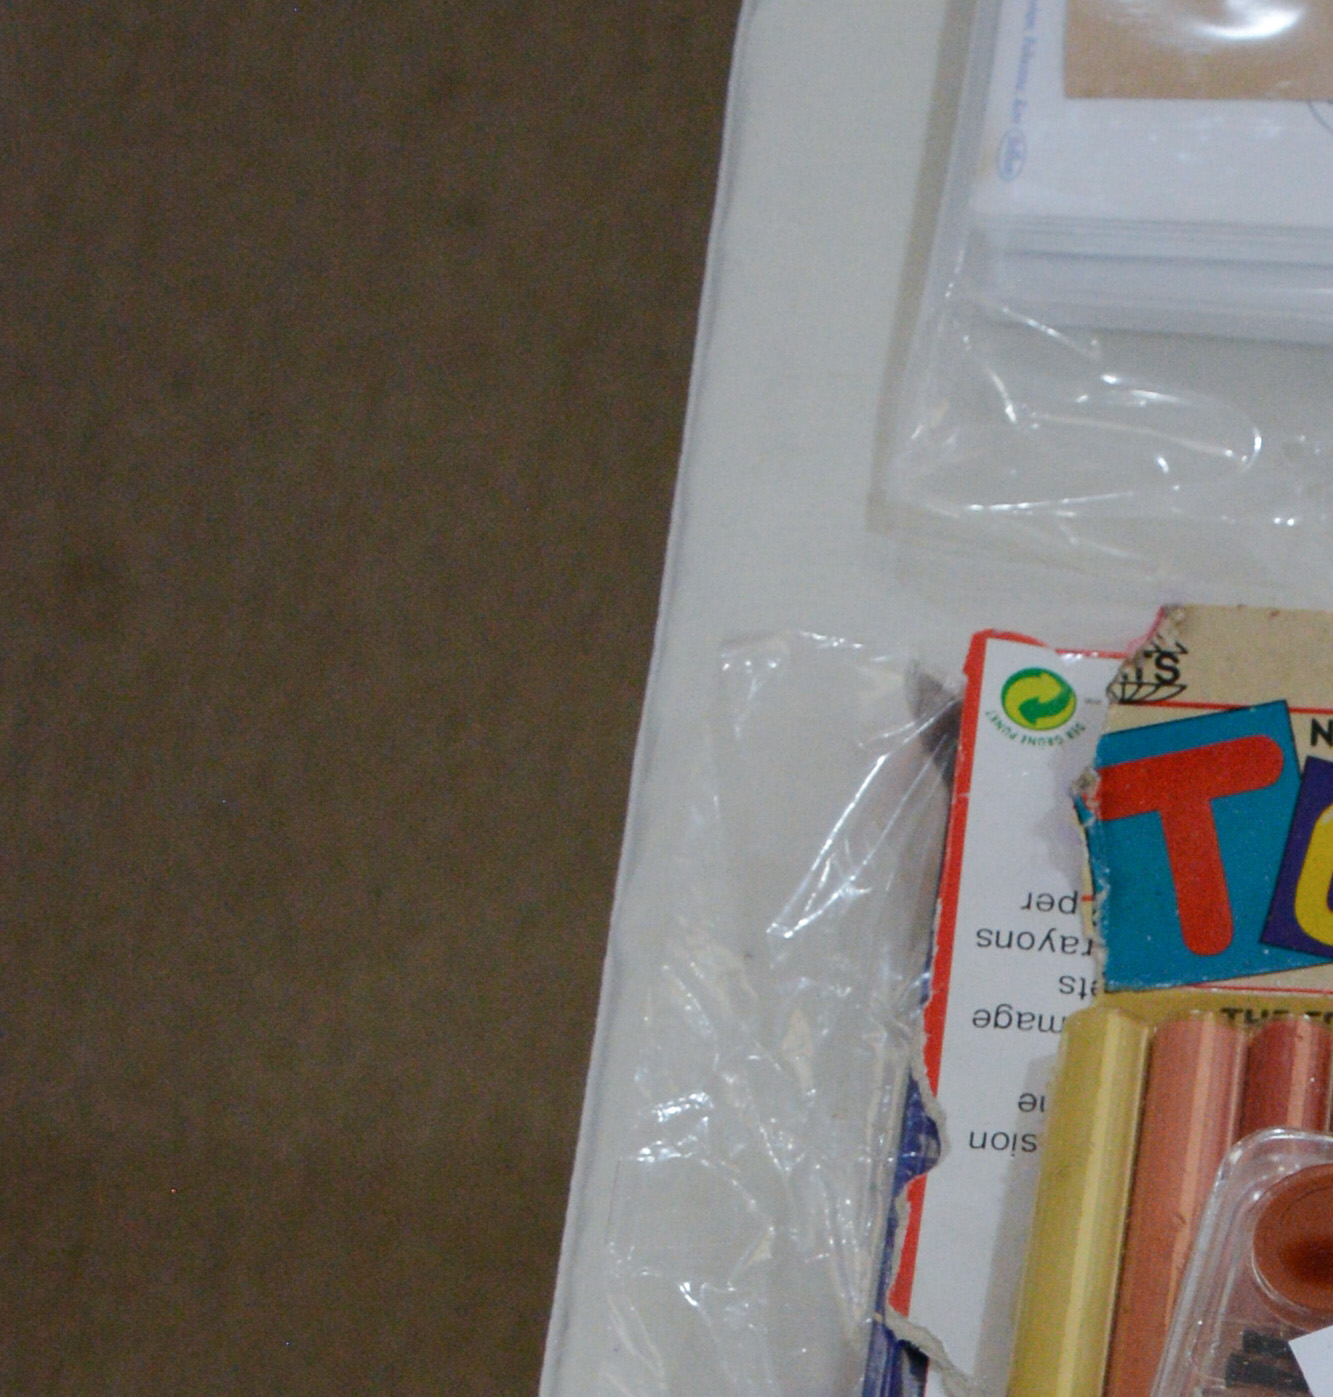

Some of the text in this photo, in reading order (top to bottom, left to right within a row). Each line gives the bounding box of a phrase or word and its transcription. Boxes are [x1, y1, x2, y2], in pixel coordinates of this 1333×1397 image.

[1020, 890, 1079, 914] per
[976, 926, 1094, 957] rayons
[969, 1131, 1038, 1157] sion
